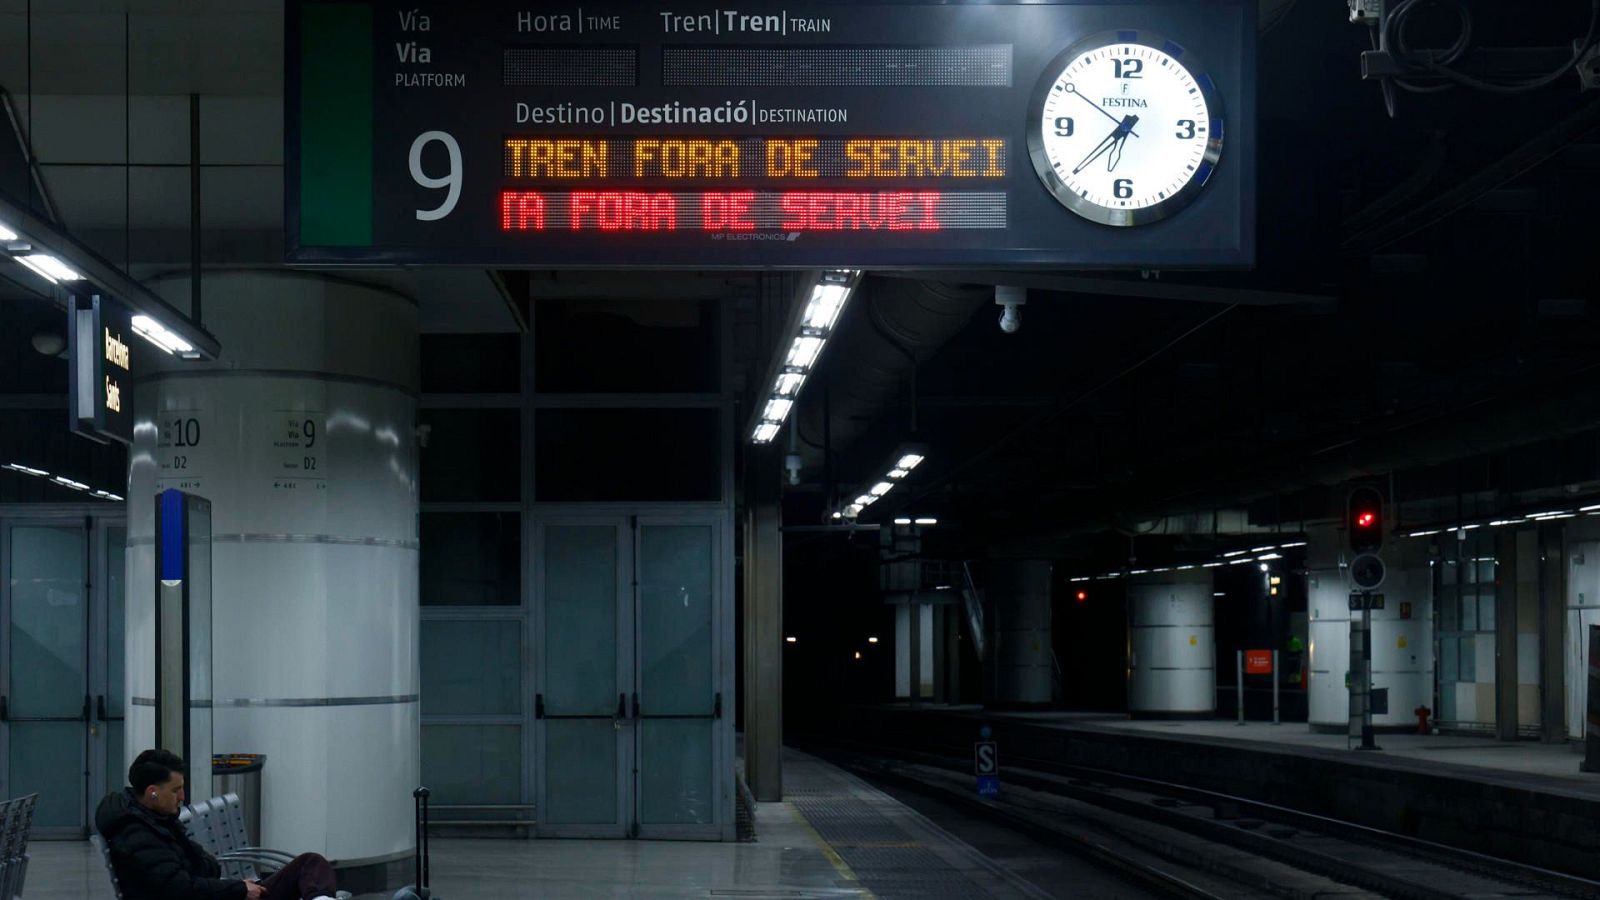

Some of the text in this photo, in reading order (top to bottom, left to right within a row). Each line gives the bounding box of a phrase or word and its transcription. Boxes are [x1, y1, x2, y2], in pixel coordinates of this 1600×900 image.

[399, 9, 430, 32] Vía
[517, 11, 621, 33] Hora TIME
[660, 10, 831, 33] Tren Tren TRAIN
[395, 42, 431, 63] Via
[1110, 58, 1143, 79] 12
[395, 73, 466, 87] PLATFORM
[516, 100, 848, 125] Destino Destinació DESTINATION
[1102, 97, 1148, 108] FESTINA
[1054, 116, 1075, 137] 9
[1175, 119, 1196, 140] 3
[507, 140, 1005, 177] TREN FORA DE SERVEI
[408, 130, 463, 221] 9
[1113, 178, 1134, 199] 6
[571, 191, 676, 229] FORA
[704, 191, 755, 229] DE
[782, 191, 941, 229] SERVEI
[173, 418, 201, 447] 10
[303, 419, 316, 448] 9
[174, 456, 187, 469] D2
[304, 457, 316, 470] D2
[979, 745, 994, 772] S
